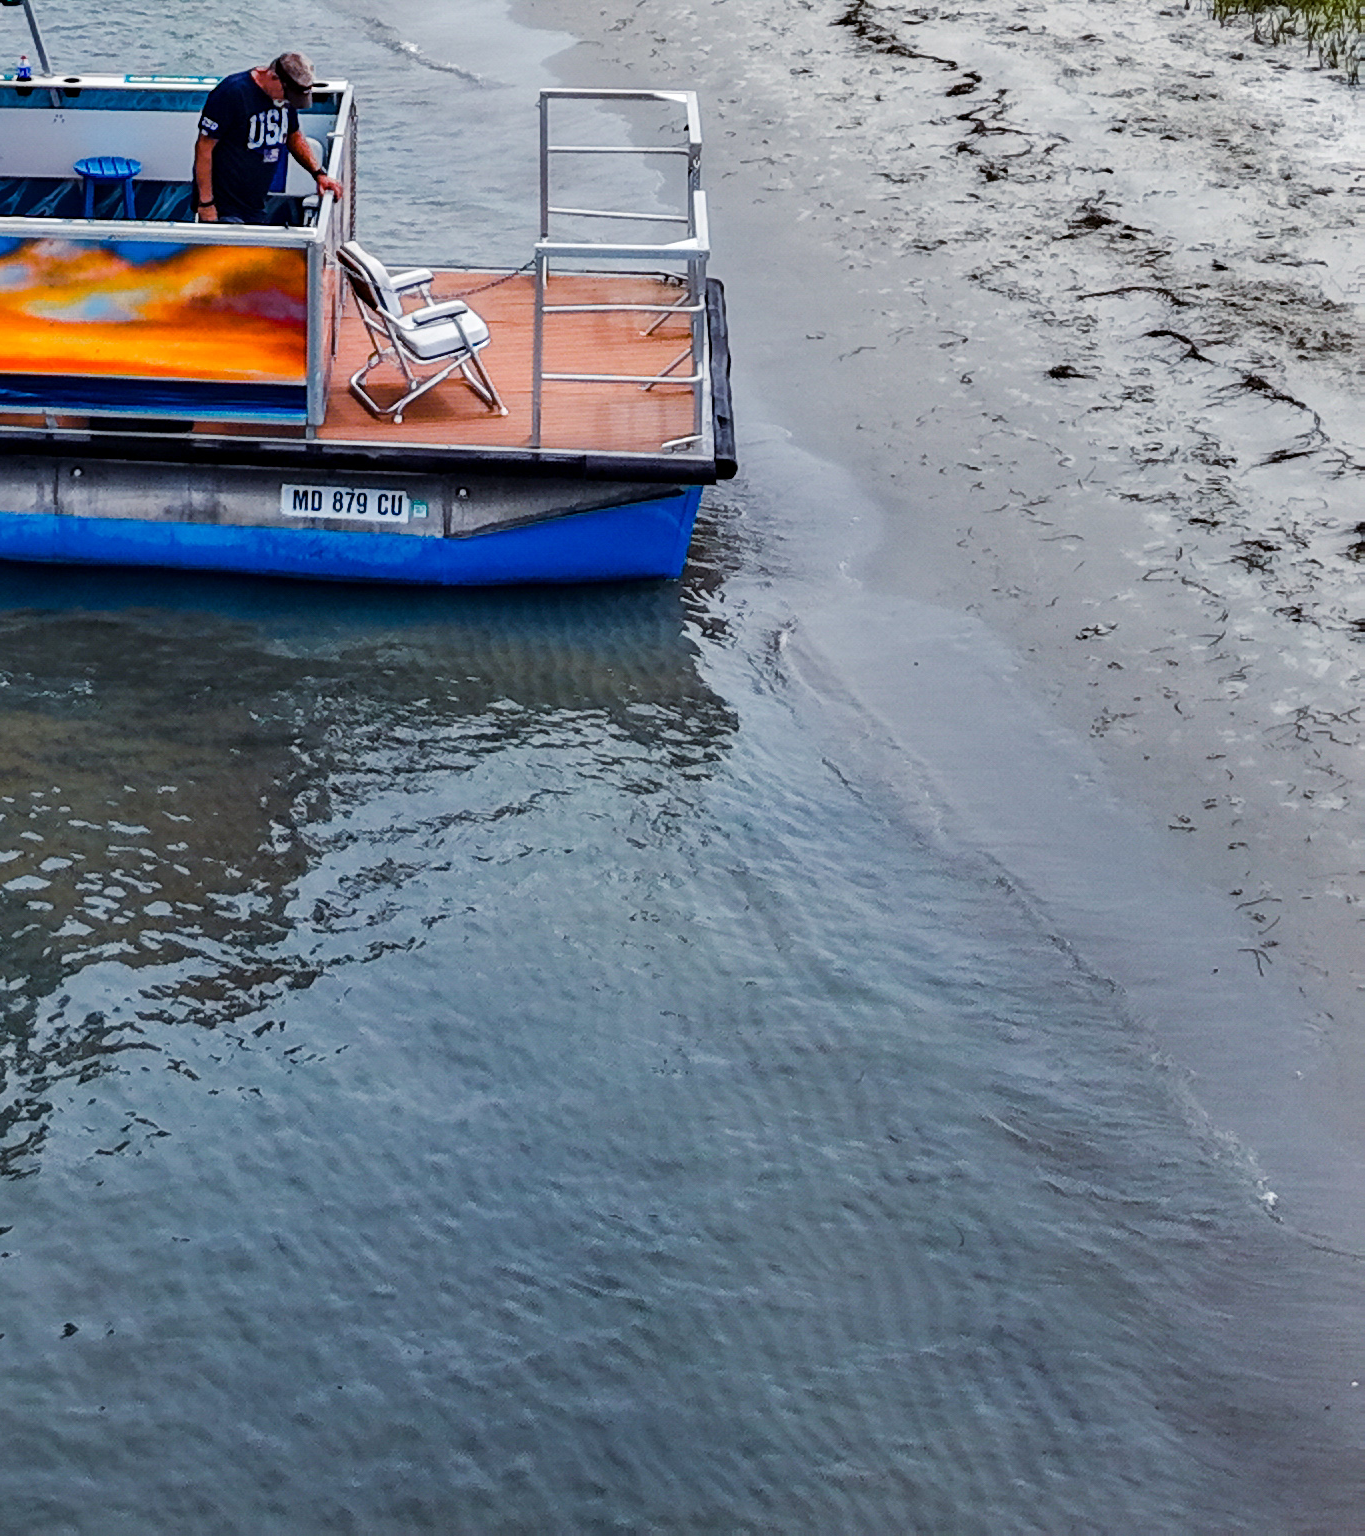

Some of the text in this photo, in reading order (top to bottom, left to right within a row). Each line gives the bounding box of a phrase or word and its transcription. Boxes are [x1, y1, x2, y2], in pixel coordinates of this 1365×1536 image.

[247, 107, 289, 150] USA
[292, 489, 323, 512] MD
[332, 491, 368, 514] 879
[377, 493, 403, 516] CU
